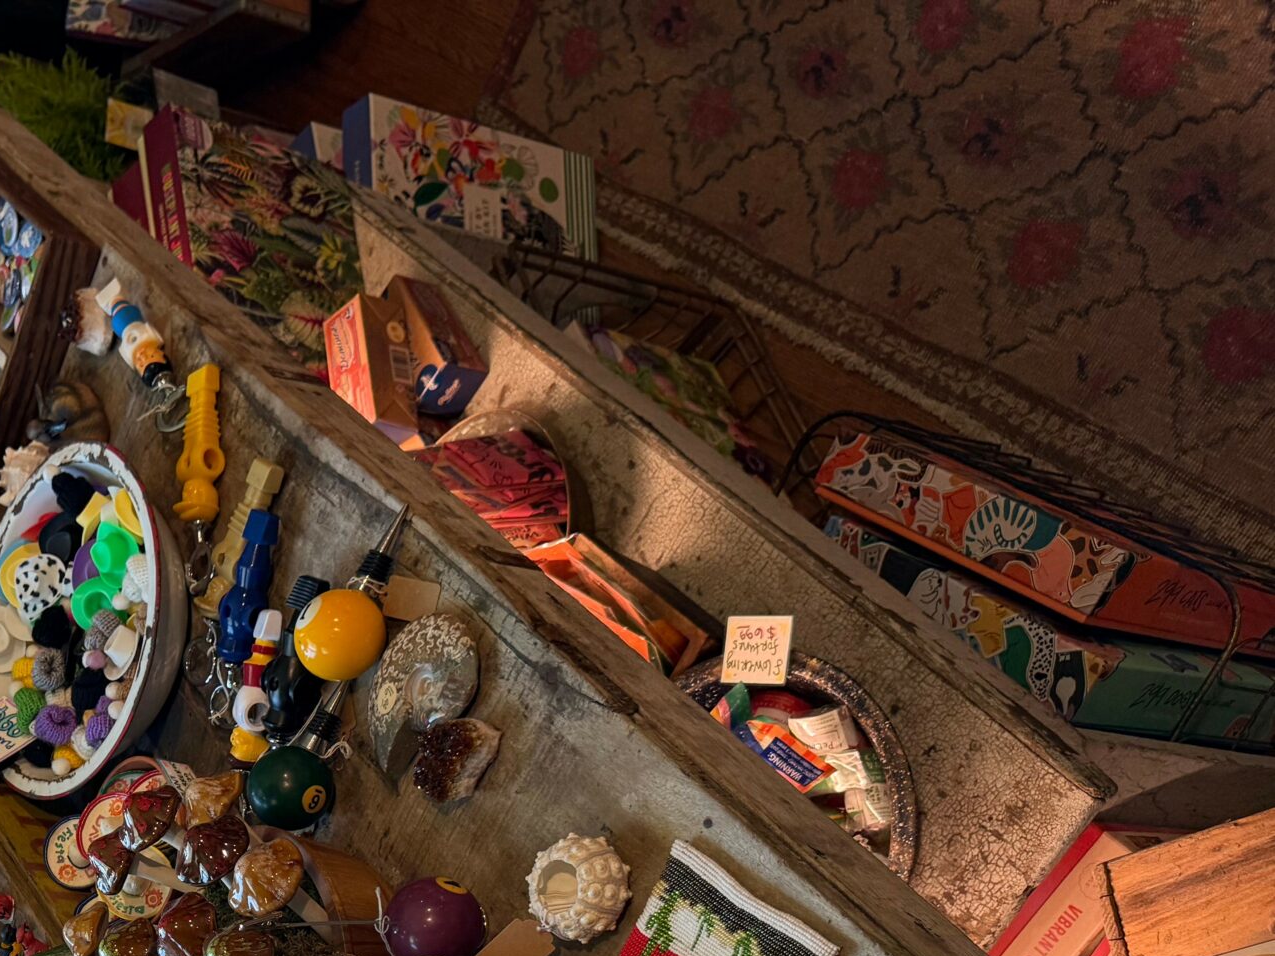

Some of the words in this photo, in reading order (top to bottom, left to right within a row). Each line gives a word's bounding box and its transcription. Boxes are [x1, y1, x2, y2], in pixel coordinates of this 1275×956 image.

[767, 752, 804, 782] WARNING:
[54, 827, 74, 864] Fiesta
[110, 895, 146, 915] iesta
